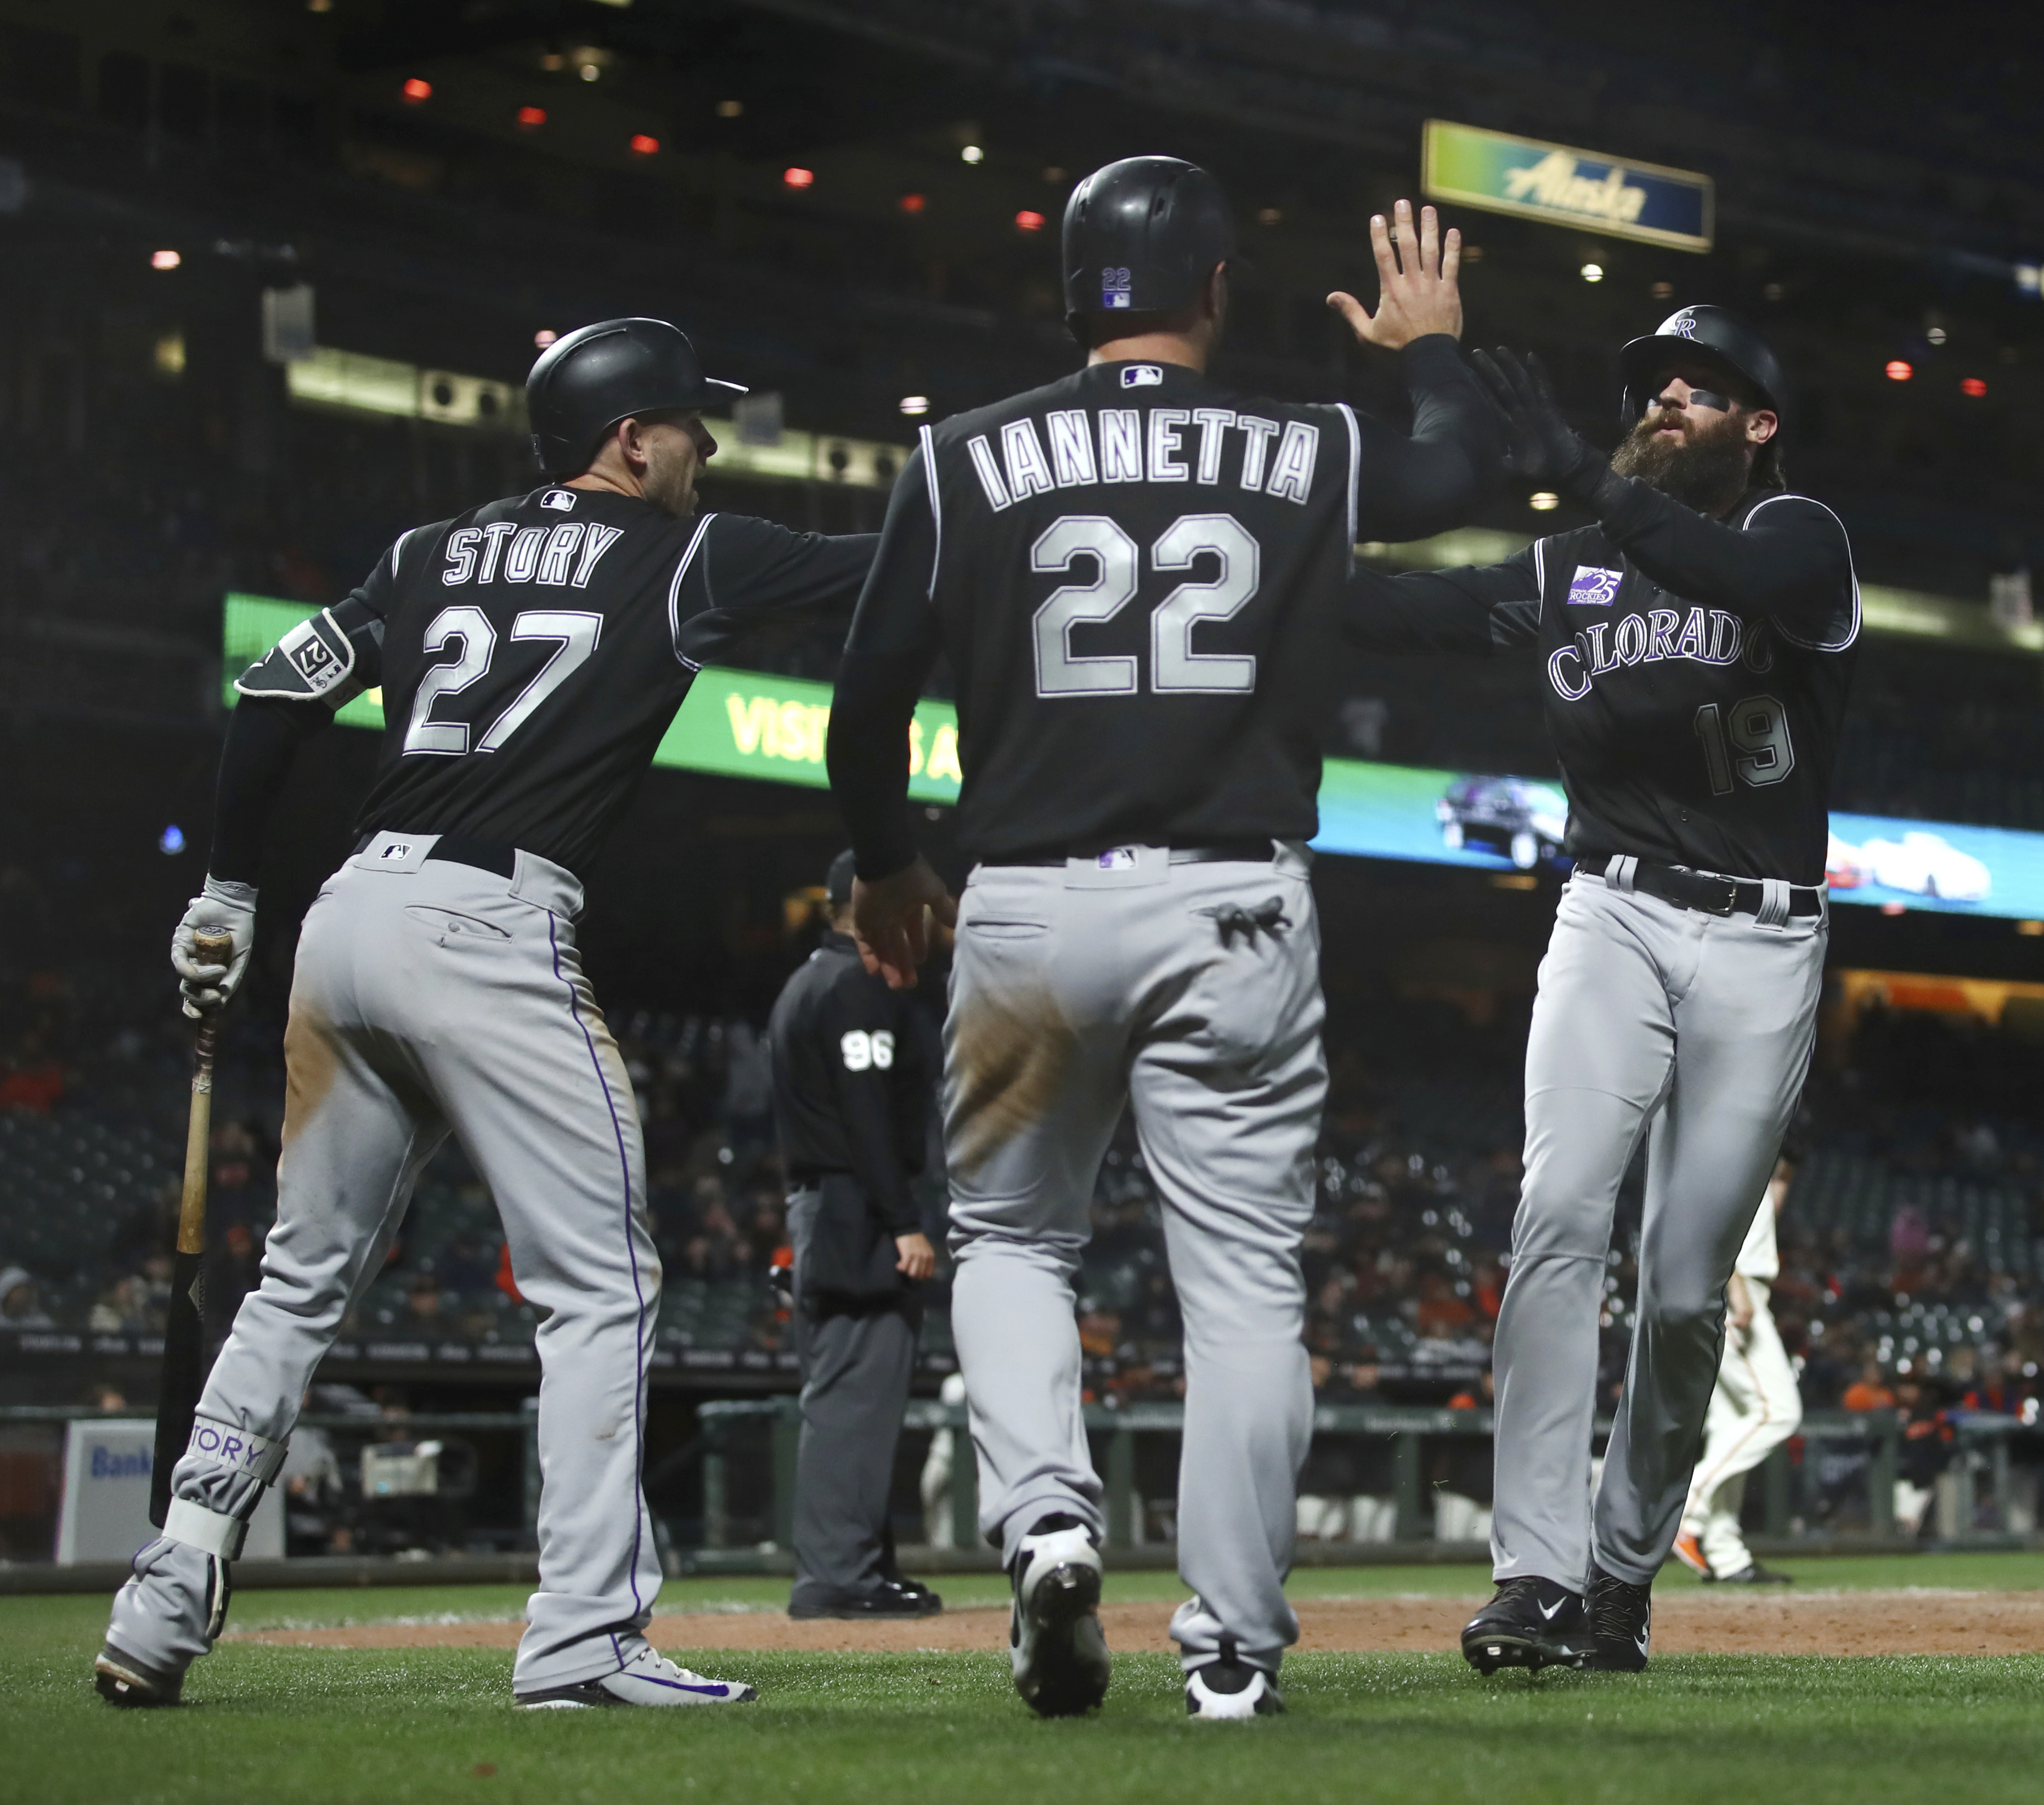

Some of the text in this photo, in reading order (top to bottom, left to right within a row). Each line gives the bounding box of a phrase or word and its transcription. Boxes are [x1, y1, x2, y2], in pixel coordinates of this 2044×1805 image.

[1102, 267, 1131, 291] 22
[967, 408, 1319, 512] IANNETTA
[442, 522, 624, 589] STORY
[1587, 574, 1618, 603] 25
[1031, 513, 1260, 699] 22
[1569, 592, 1606, 601] ROCKIES
[300, 641, 328, 675] 27
[402, 606, 603, 756] 27
[726, 693, 831, 763] VISI
[1693, 694, 1794, 796] 19
[840, 1029, 895, 1072] 96
